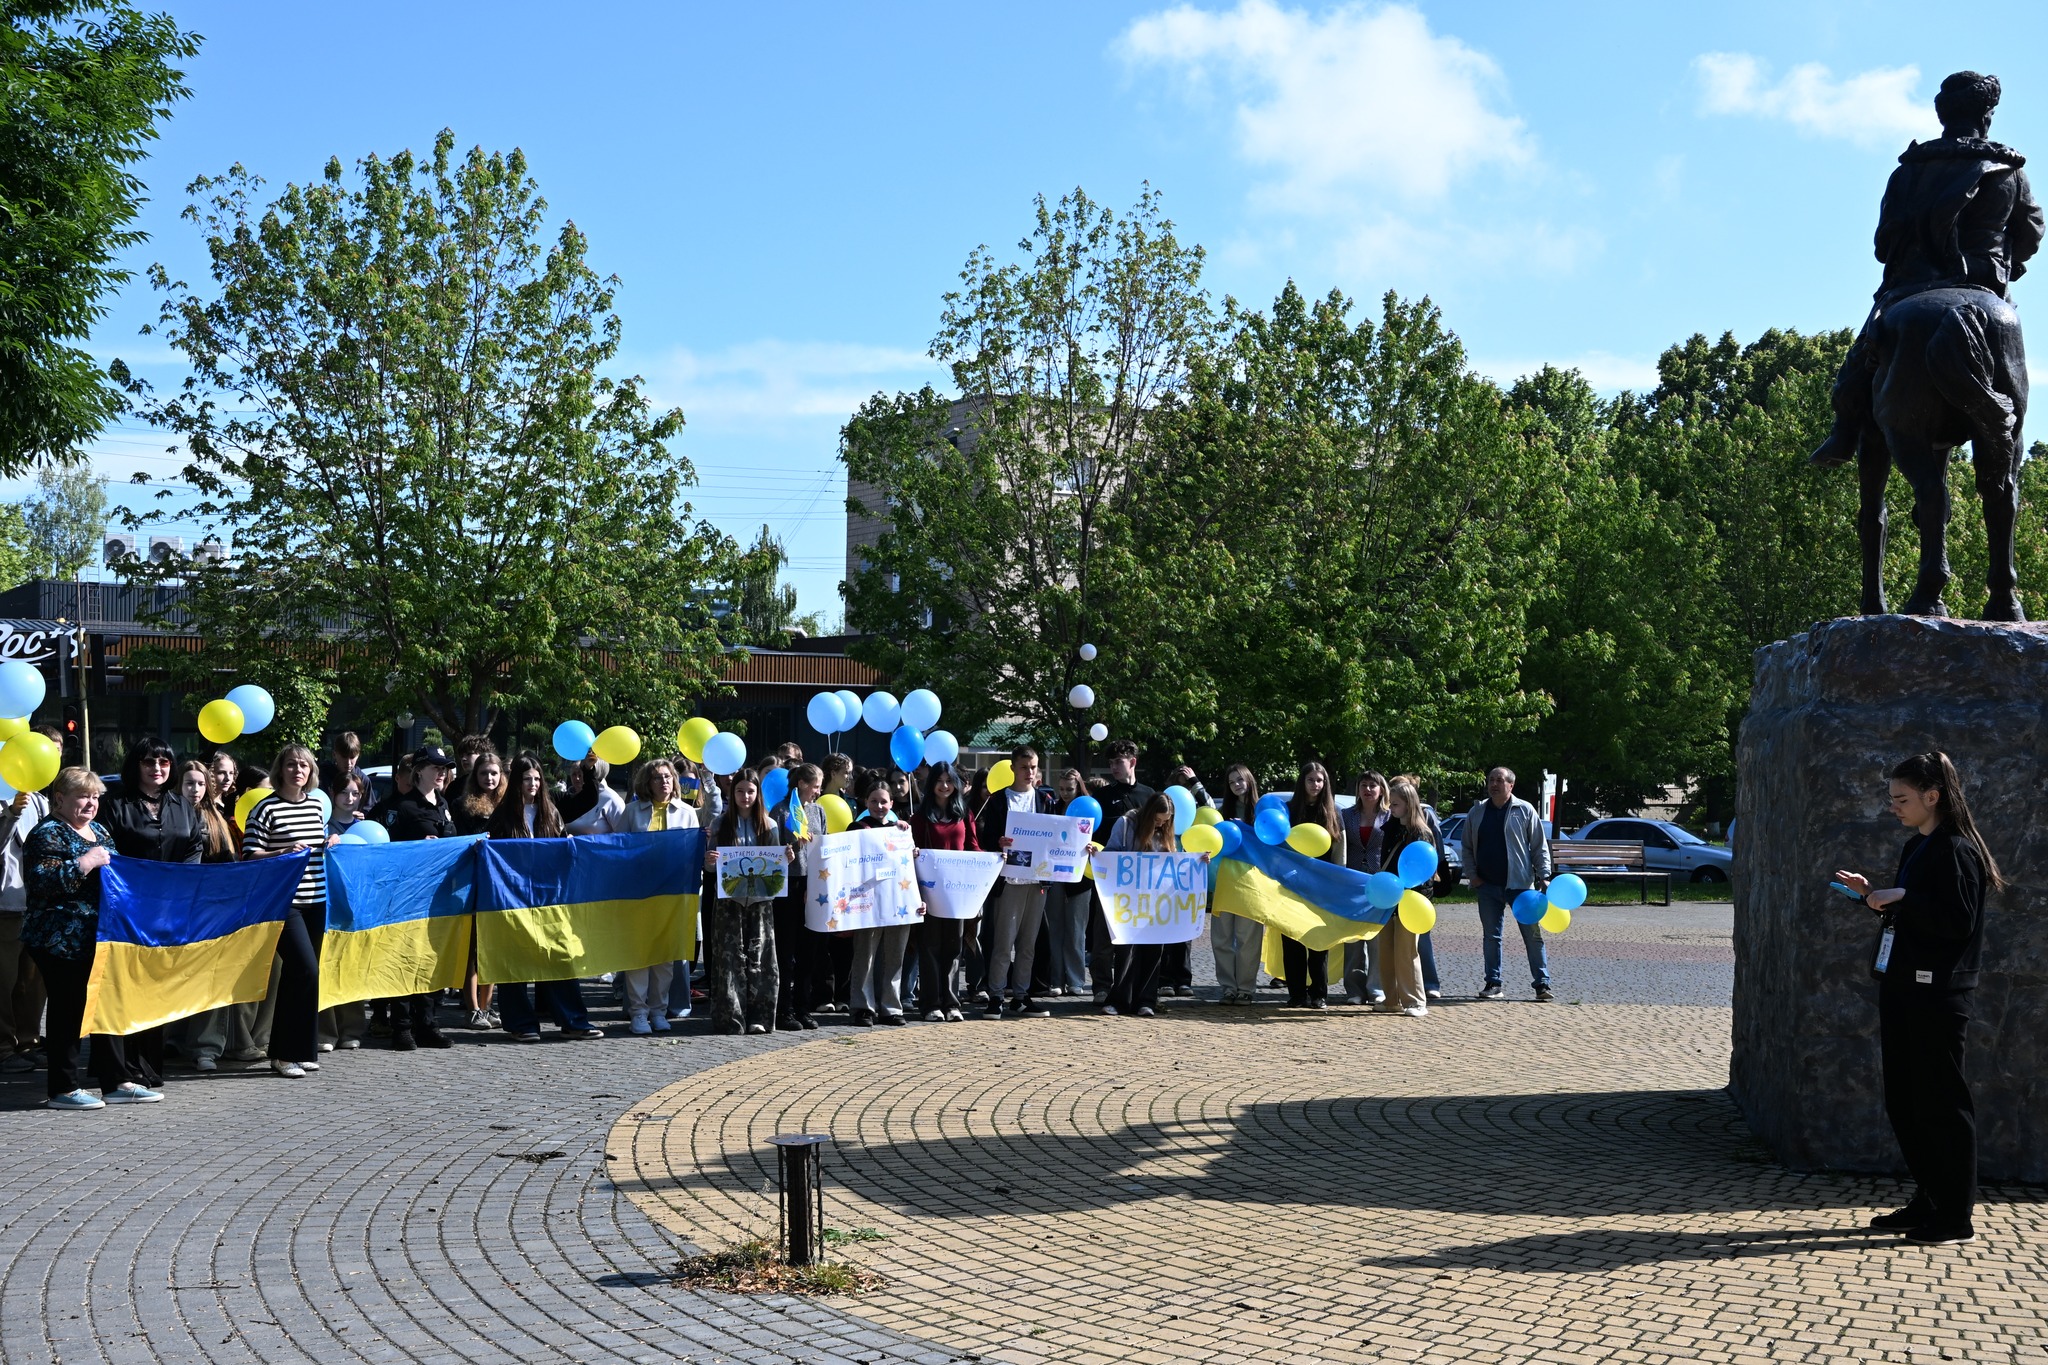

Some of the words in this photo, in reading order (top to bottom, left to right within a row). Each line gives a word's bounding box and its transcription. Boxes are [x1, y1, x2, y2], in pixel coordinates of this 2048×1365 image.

[1012, 826, 1053, 838] Вітаємо
[823, 844, 852, 856] Вітаємо
[1049, 847, 1077, 857] вдома
[858, 853, 884, 865] рідній
[945, 880, 978, 891] додому
